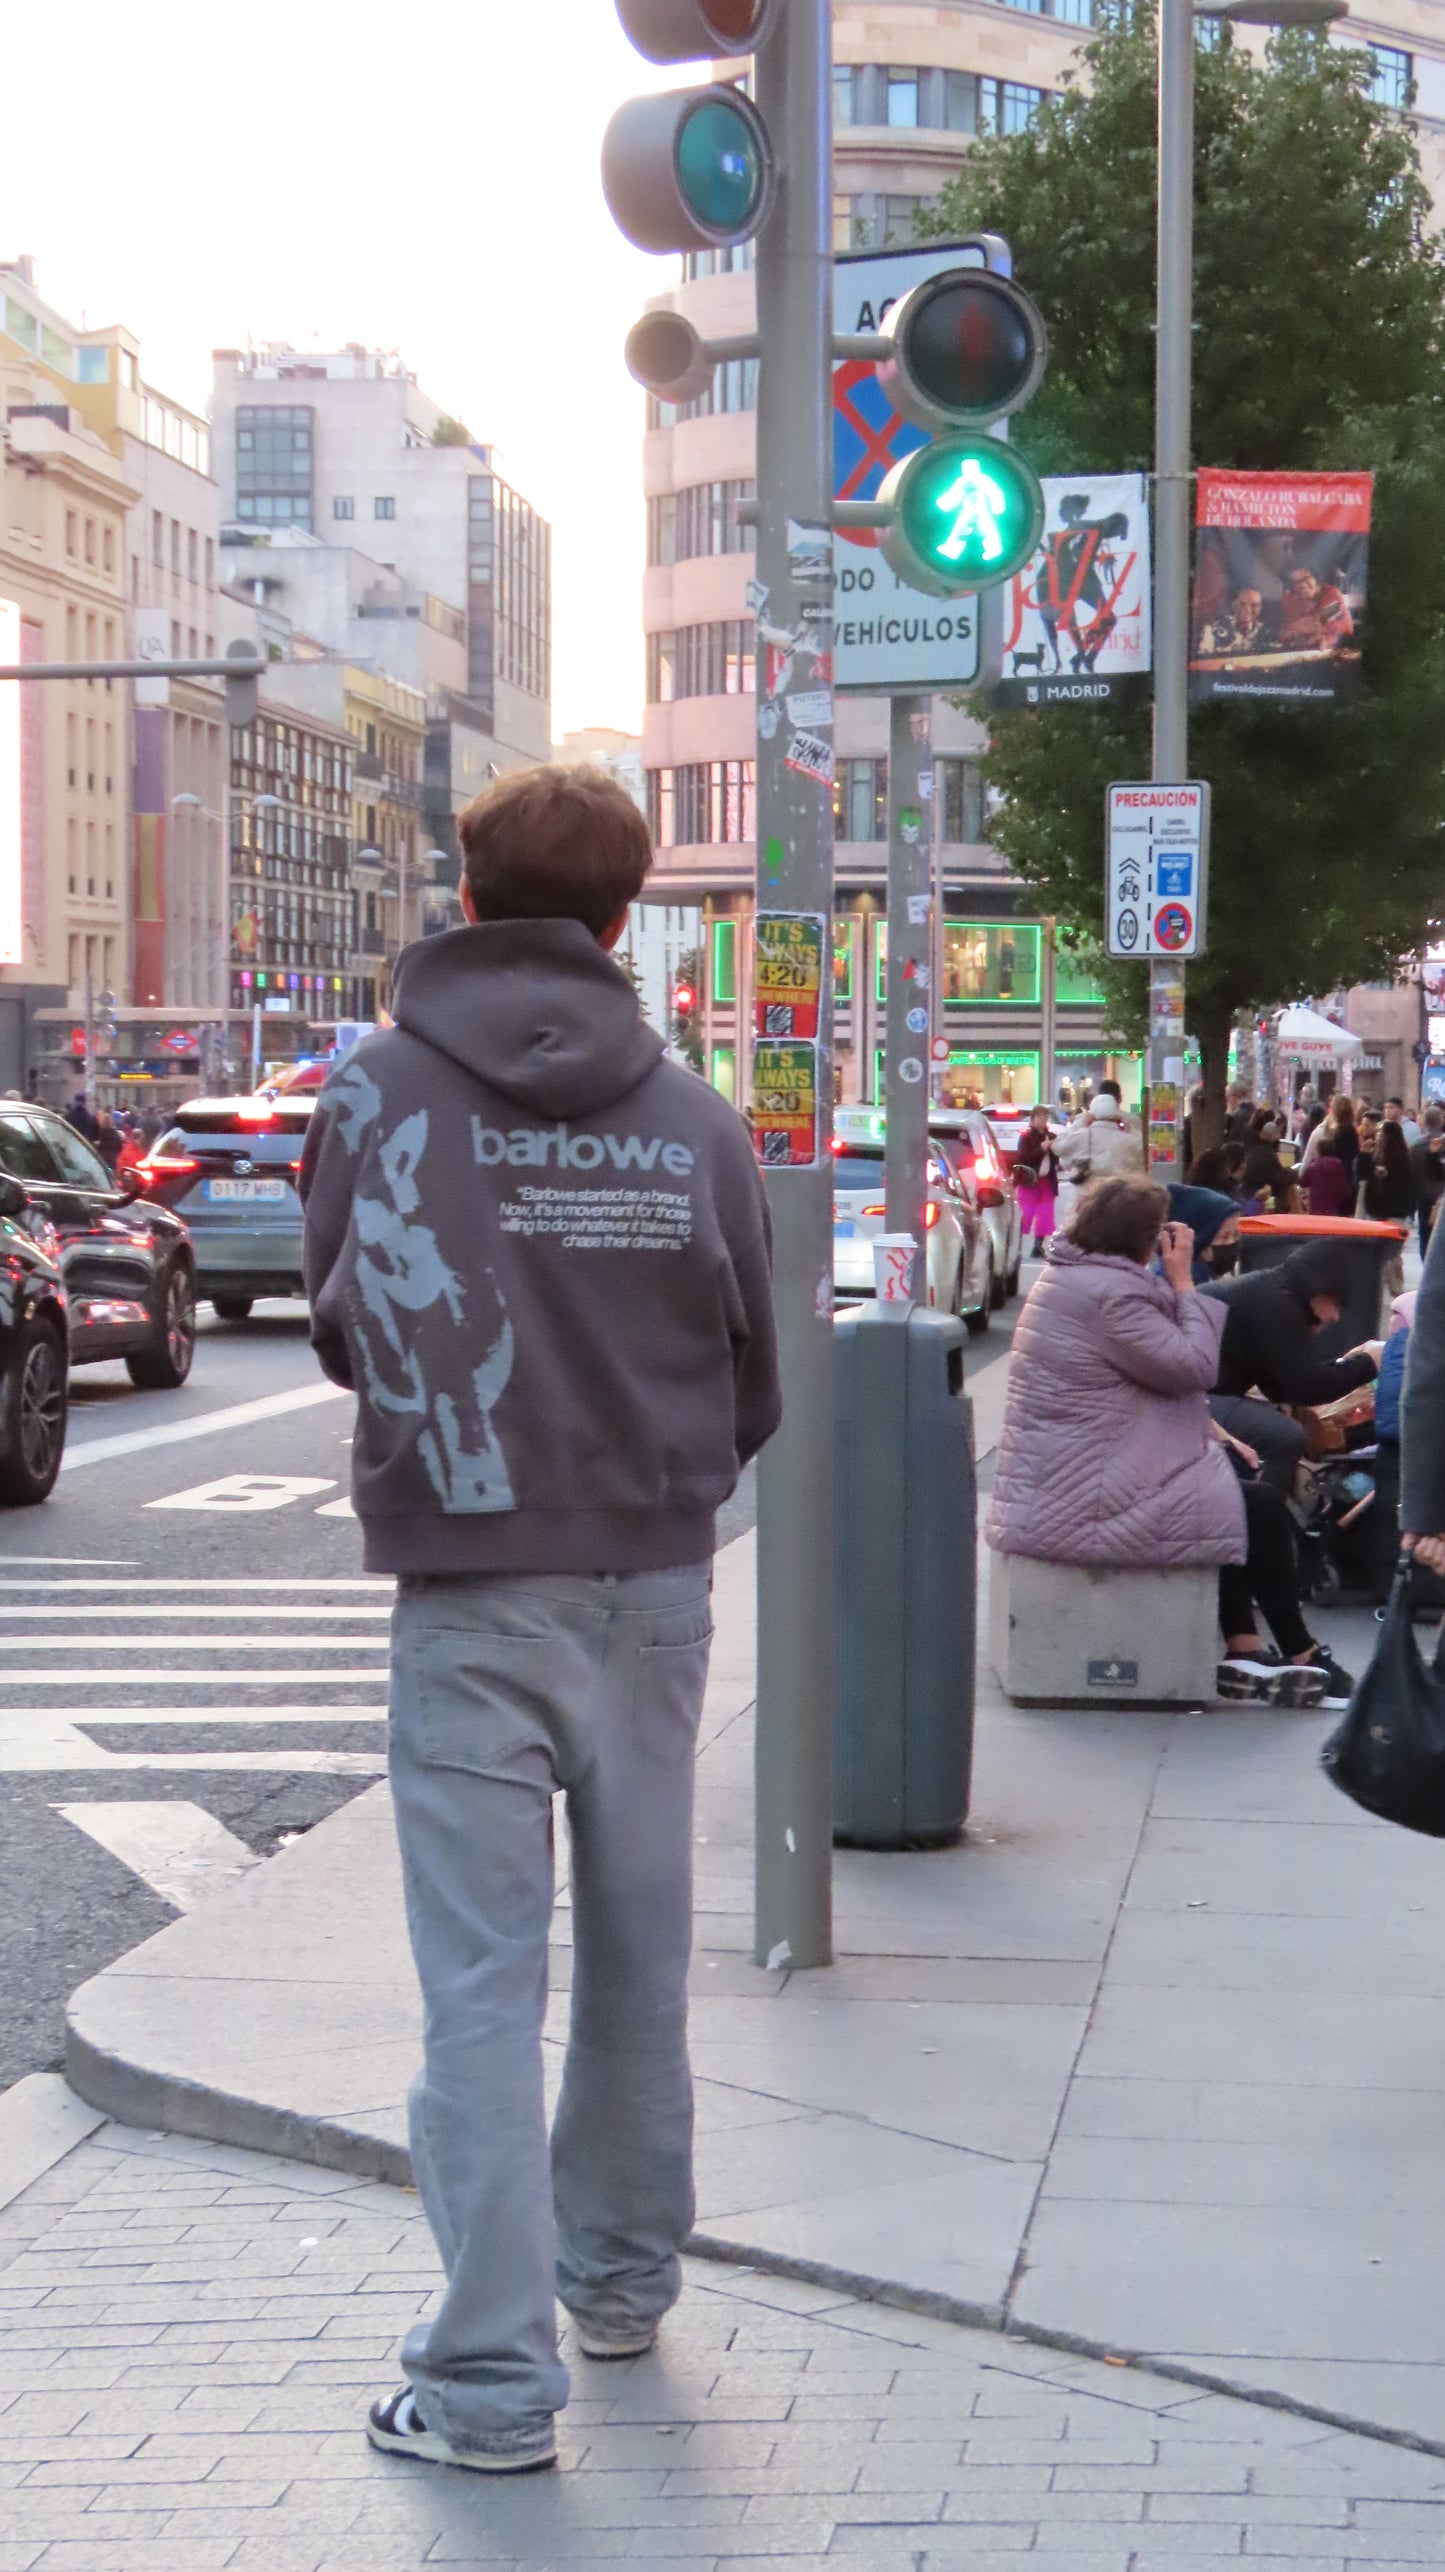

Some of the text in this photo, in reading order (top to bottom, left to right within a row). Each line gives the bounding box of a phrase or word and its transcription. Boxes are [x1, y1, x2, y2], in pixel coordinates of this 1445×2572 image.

[833, 567, 875, 592] DO
[1046, 684, 1111, 700] MADRID
[1115, 789, 1198, 808] PRECAUCIÓN
[764, 922, 804, 944] IT'S
[1120, 919, 1135, 941] 30
[759, 965, 807, 987] 4:20
[1301, 1042, 1334, 1052] GUYS
[469, 1113, 695, 1177] barlowe
[213, 1182, 250, 1196] 0117
[577, 1188, 624, 1203] started
[624, 1191, 640, 1203] as
[641, 1192, 651, 1203] a
[651, 1190, 691, 1207] brand.
[500, 1202, 692, 1220] Now, it's a movement for those
[536, 1219, 550, 1233] to
[551, 1218, 570, 1232] do
[570, 1219, 629, 1233] whatever
[640, 1220, 676, 1235] takes
[677, 1221, 692, 1236] to
[562, 1234, 602, 1248] chase
[602, 1235, 632, 1249] their
